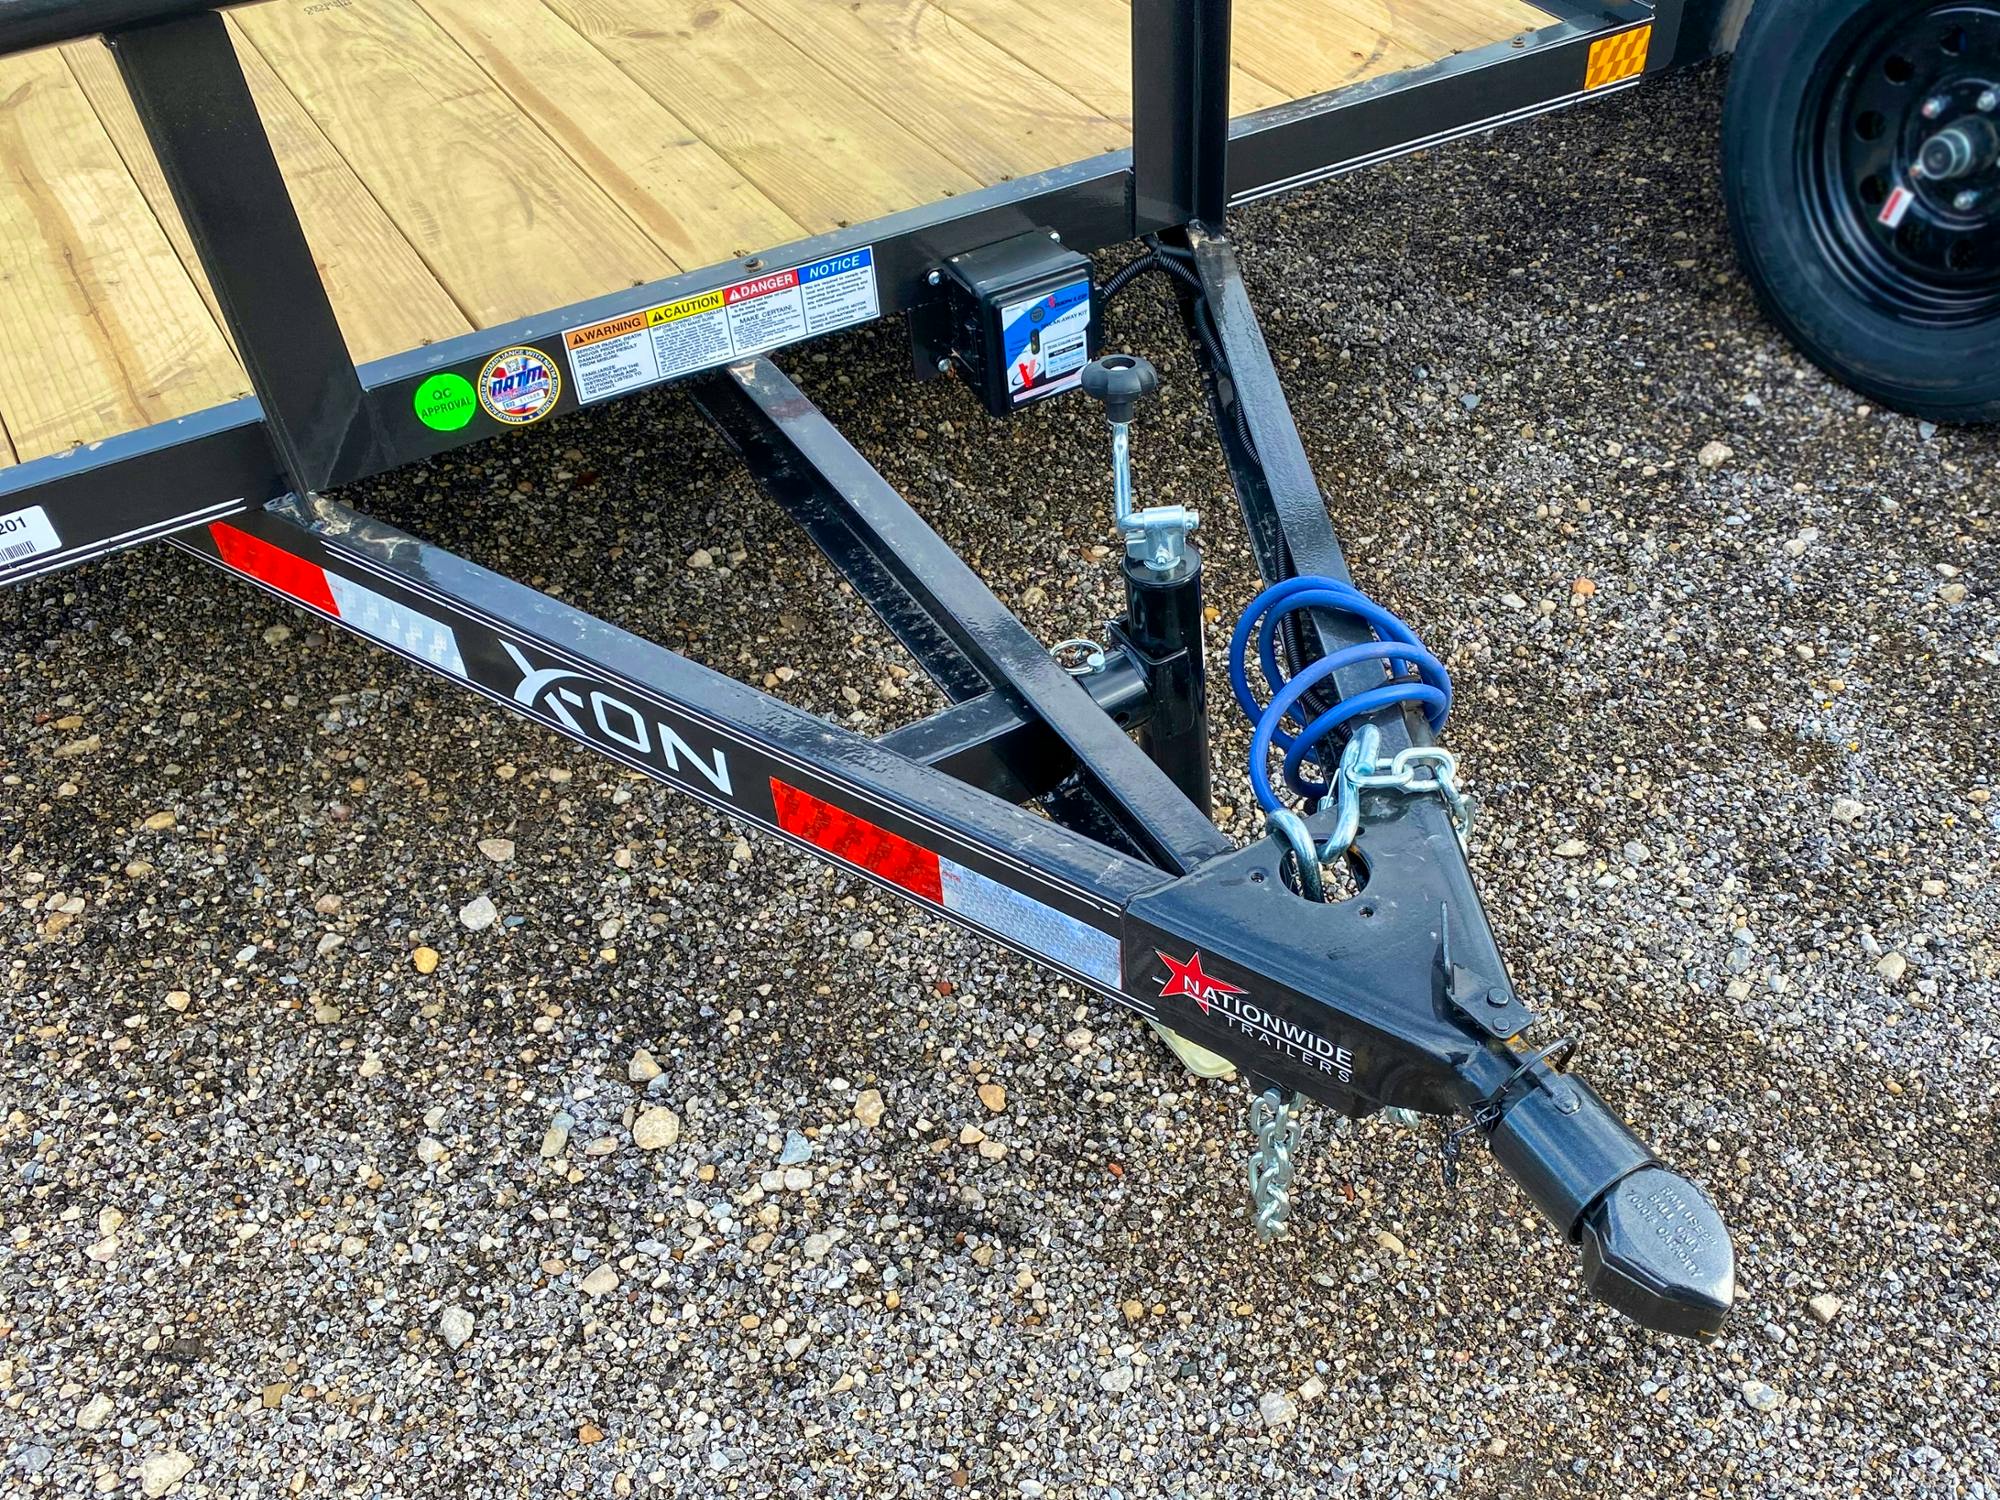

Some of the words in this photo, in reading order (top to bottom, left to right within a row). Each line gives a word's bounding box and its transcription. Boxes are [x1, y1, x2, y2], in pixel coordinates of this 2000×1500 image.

[809, 255, 860, 279] NOTICE
[741, 274, 793, 297] DANGER
[664, 295, 719, 318] CAUTION
[584, 317, 641, 341] WARNING
[740, 314, 759, 324] MAKE
[578, 354, 602, 363] DAMAGE
[492, 366, 543, 396] NATM
[615, 374, 633, 382] LISTED
[432, 387, 452, 401] QC
[421, 396, 473, 419] APPROVAL
[1183, 974, 1353, 1069] NATIONWIDE
[1225, 1014, 1351, 1084] TRAILERS
[1647, 1192, 1675, 1222] BALL
